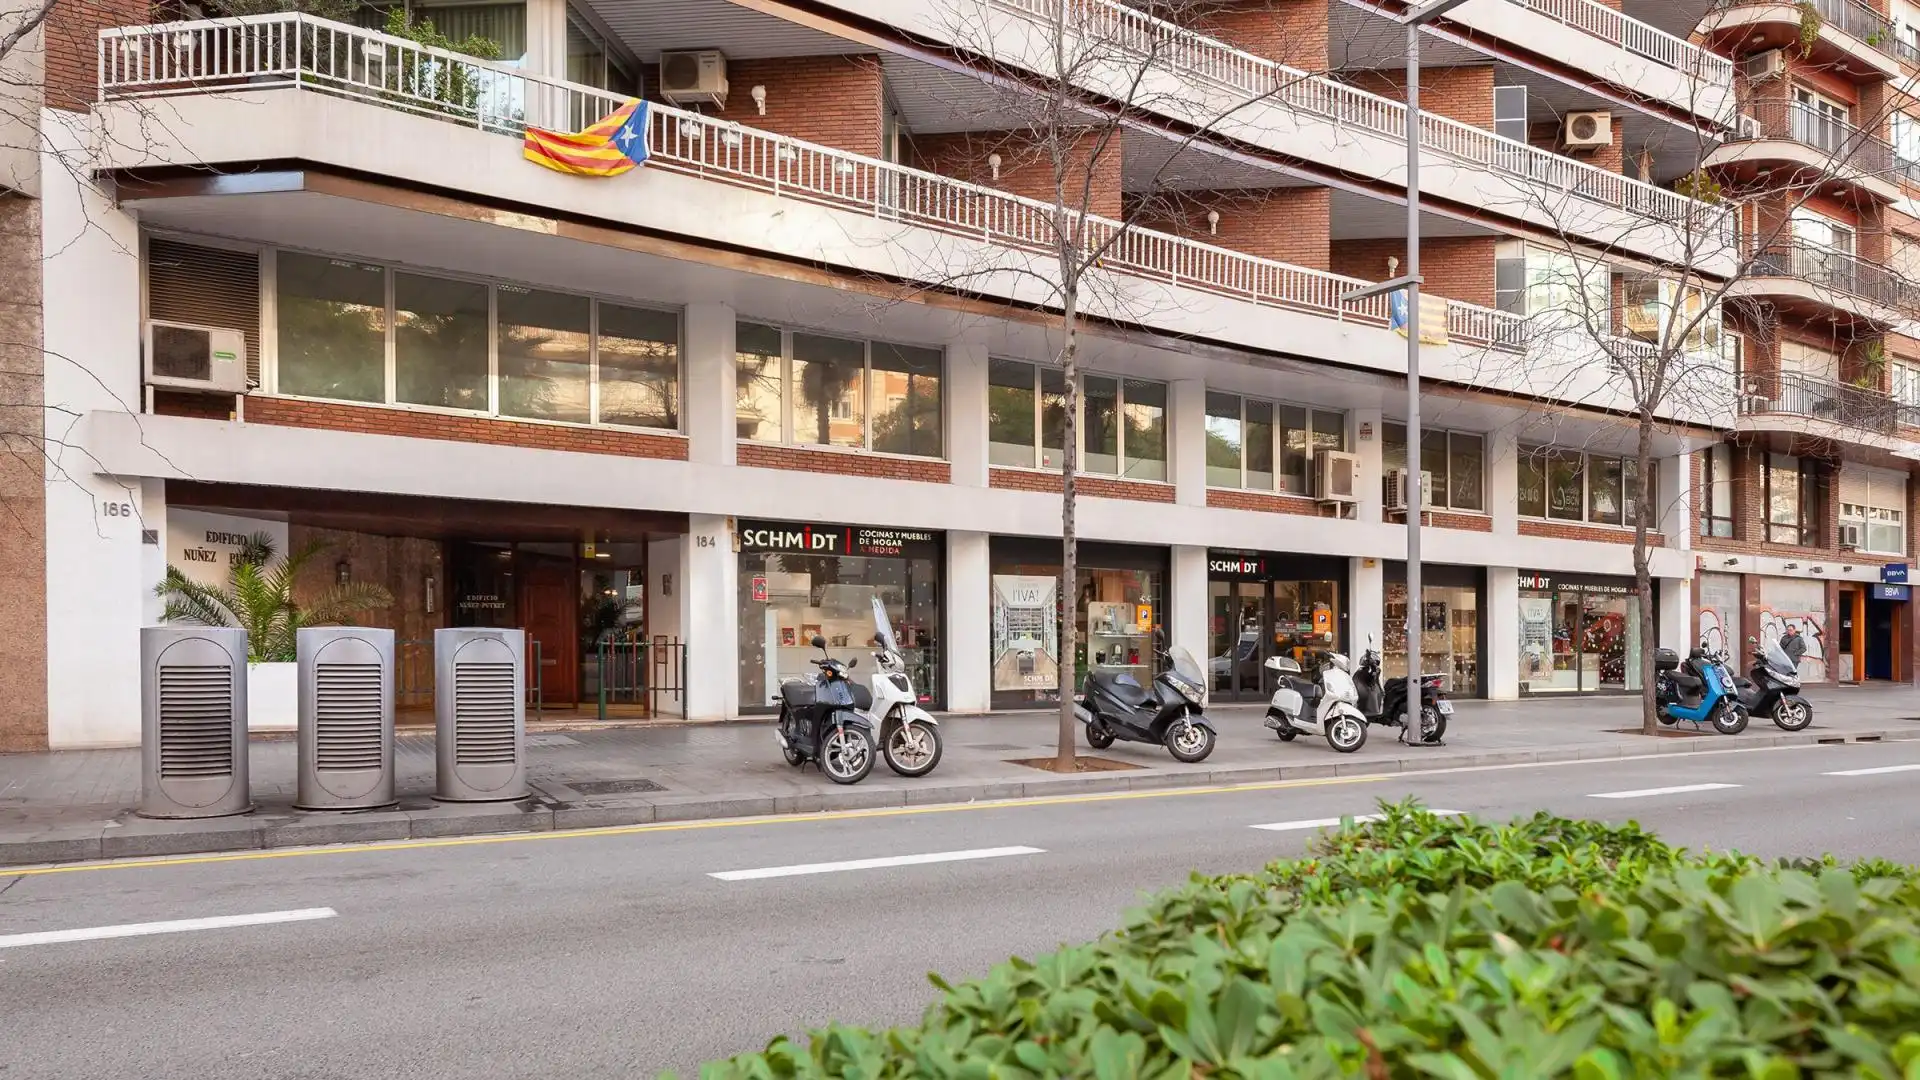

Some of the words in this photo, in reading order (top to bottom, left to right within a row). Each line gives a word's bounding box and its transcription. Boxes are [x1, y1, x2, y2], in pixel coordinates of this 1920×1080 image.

[103, 501, 131, 517] 186
[206, 530, 248, 546] EDIFICIO
[859, 529, 894, 539] COCINAS
[894, 531, 900, 539] Y
[901, 532, 931, 541] MUEBLES
[696, 535, 716, 549] 184
[859, 538, 870, 546] DE
[872, 538, 903, 547] HOGAR
[183, 546, 217, 562] NUÑEZ
[868, 546, 900, 555] MEDIDA
[1557, 583, 1580, 591] COCINAS
[1584, 584, 1604, 592] MUEBLES
[1611, 586, 1627, 594] HOGAR
[1885, 588, 1899, 596] BBVA
